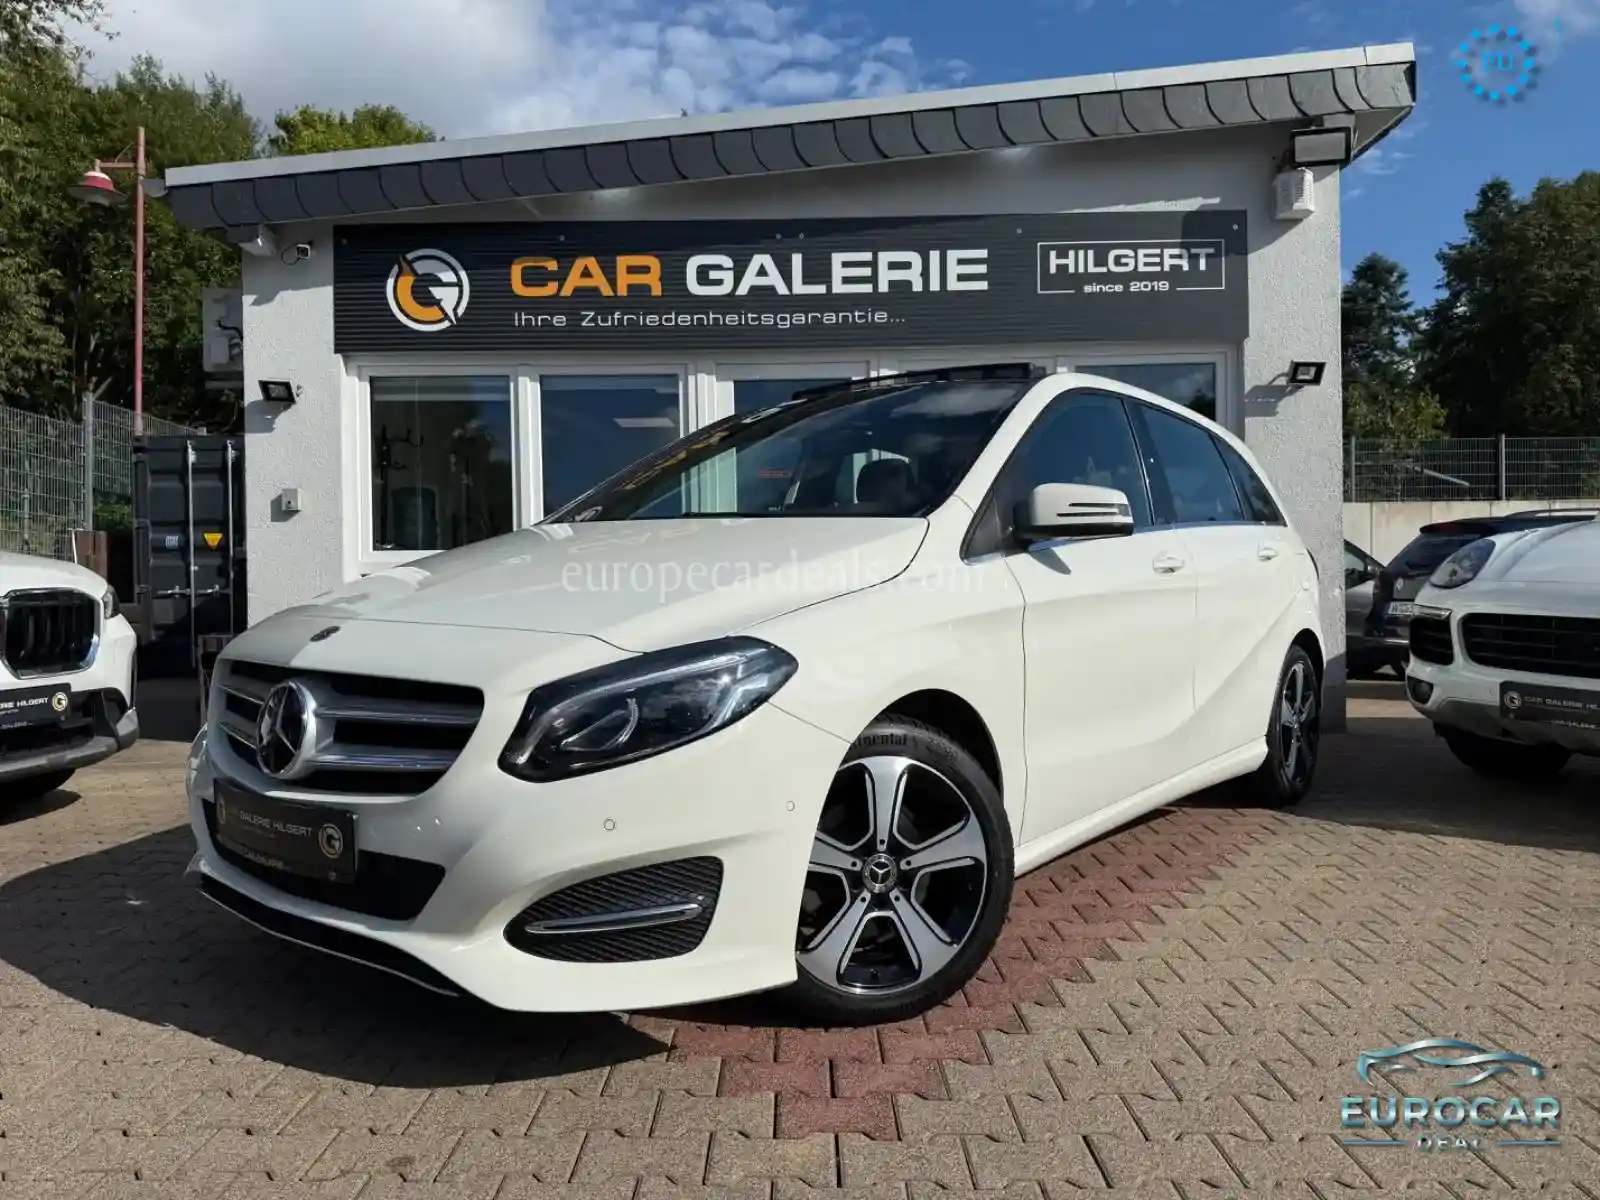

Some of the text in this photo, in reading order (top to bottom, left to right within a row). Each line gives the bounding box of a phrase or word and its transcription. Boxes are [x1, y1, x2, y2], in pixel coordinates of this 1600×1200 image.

[1049, 248, 1215, 274] HILGERT
[510, 249, 988, 297] CAR GALERIE
[1083, 280, 1170, 293] since 2019
[514, 308, 906, 329] Ihre Zufriedenheitsgarantie...
